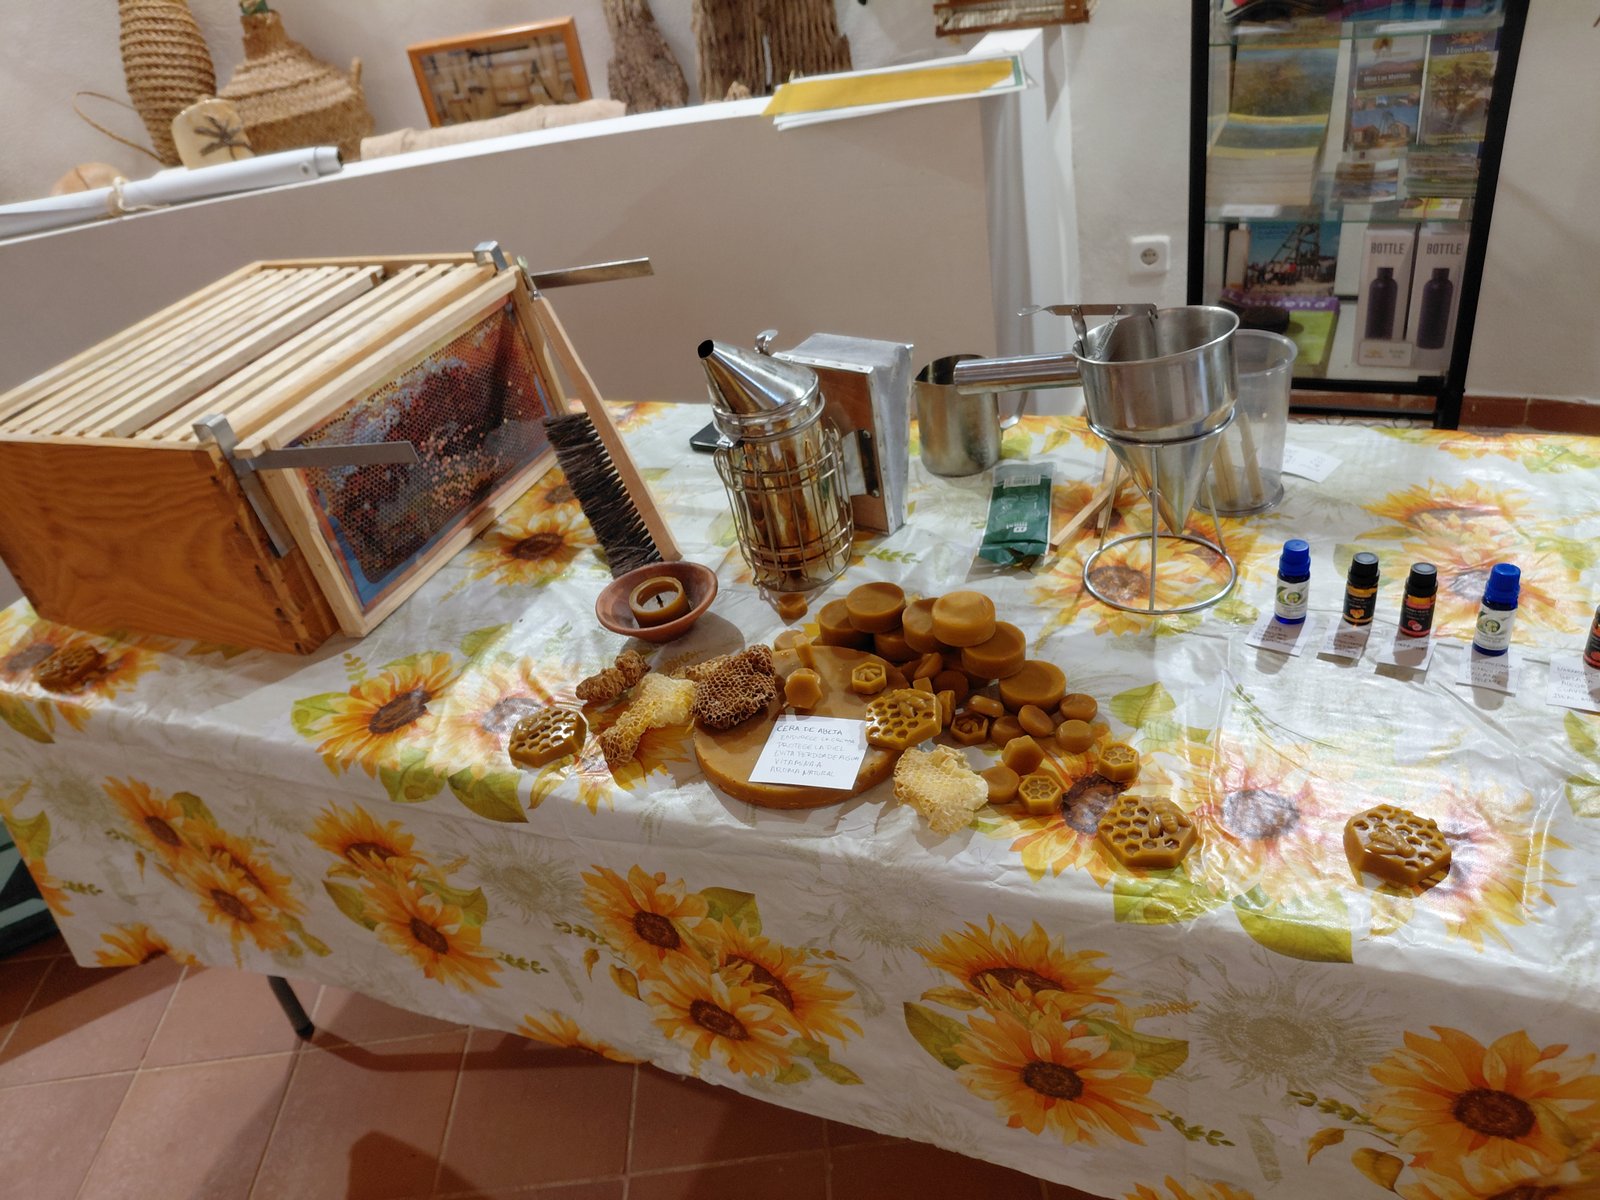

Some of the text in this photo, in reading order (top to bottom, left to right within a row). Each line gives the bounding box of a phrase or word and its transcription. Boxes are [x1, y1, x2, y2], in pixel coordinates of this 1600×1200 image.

[1370, 242, 1405, 255] BOTTLE
[1426, 243, 1462, 255] BOTTLE
[775, 759, 814, 767] VITAMINA
[769, 766, 836, 777] AROMA NATURAL
